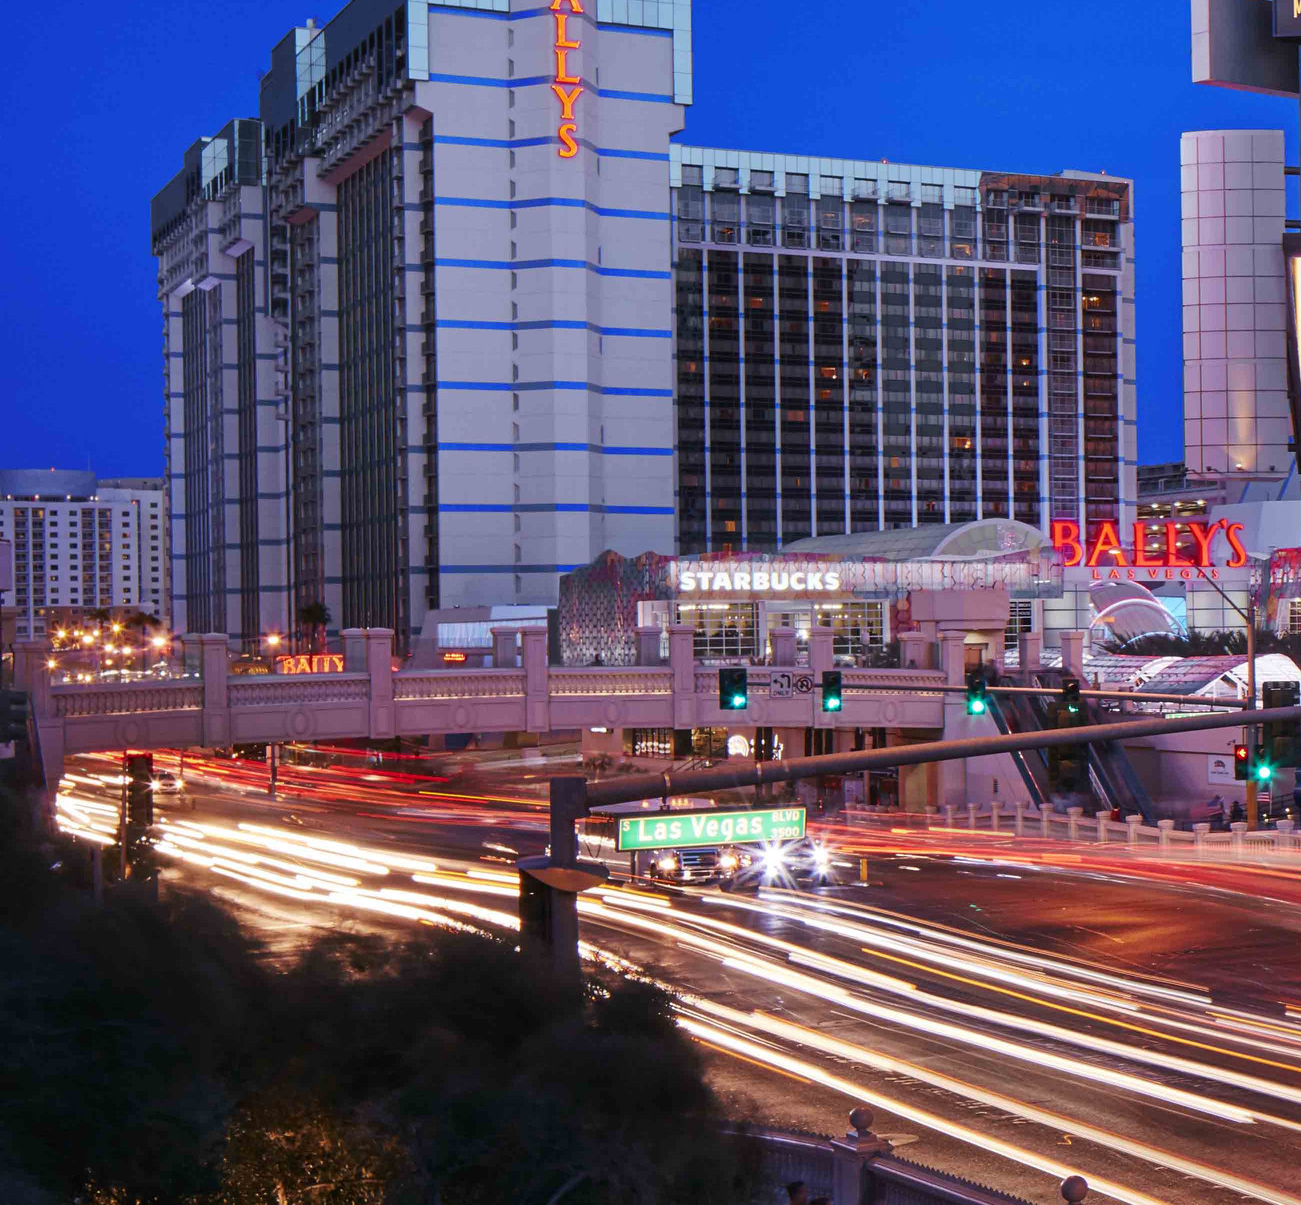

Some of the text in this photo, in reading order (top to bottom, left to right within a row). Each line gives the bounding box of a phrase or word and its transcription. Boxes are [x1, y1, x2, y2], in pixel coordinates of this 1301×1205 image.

[1051, 518, 1249, 568] BALLY'S
[679, 570, 841, 592] STARBUCKS
[1092, 568, 1220, 580] LAS VEGAS
[622, 810, 800, 842] S Las Vegas BLVD
[770, 826, 800, 839] 3500
